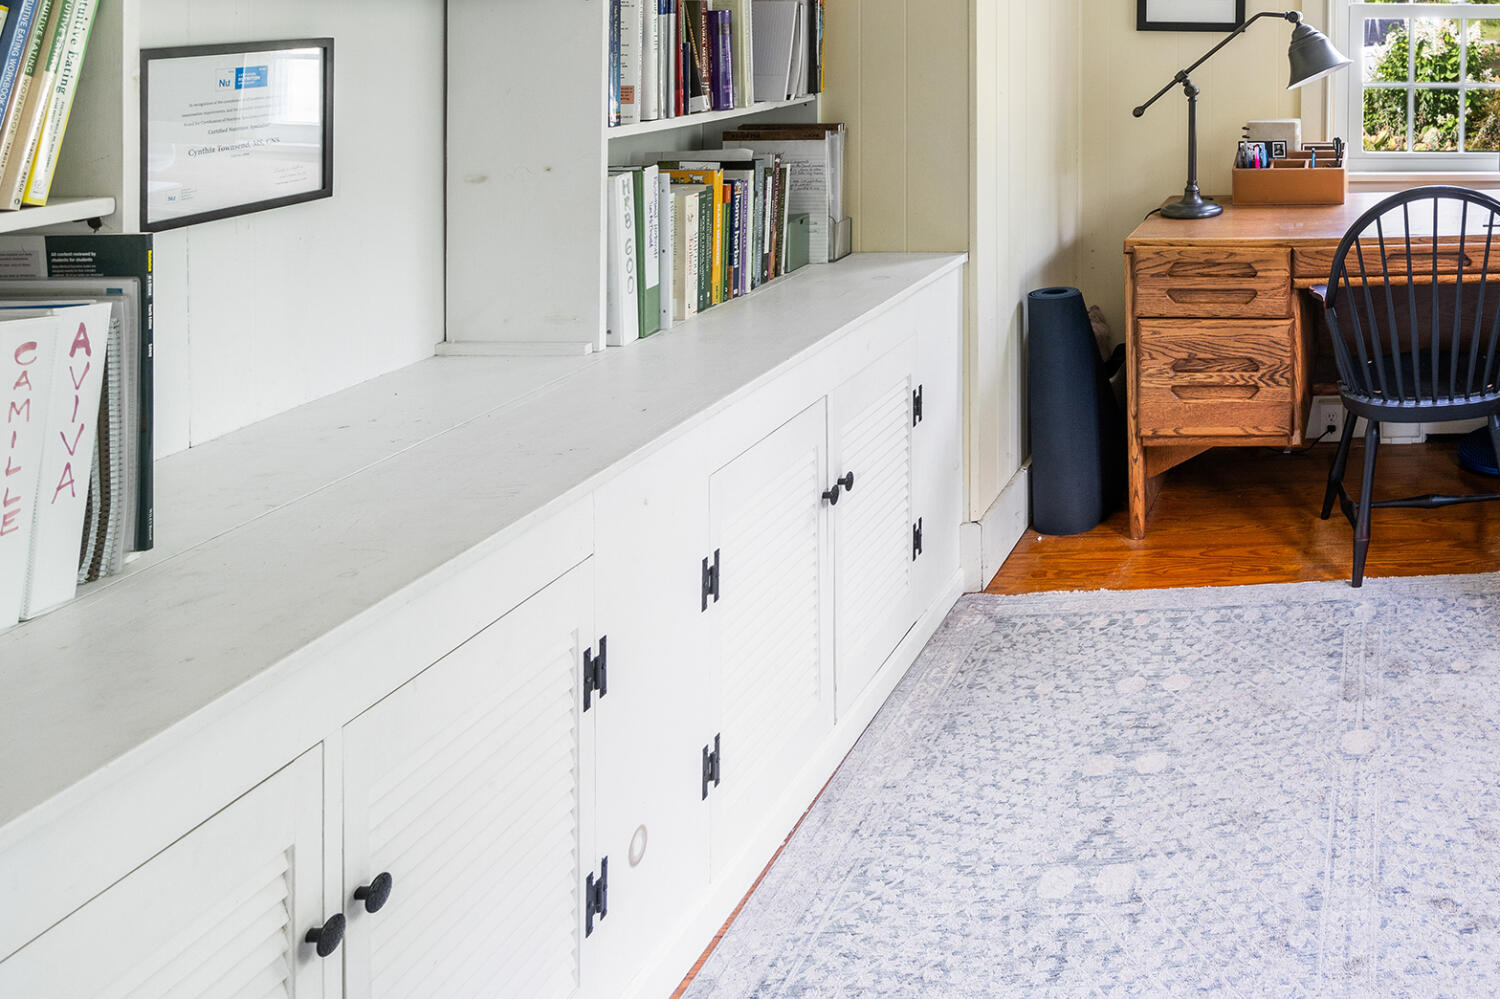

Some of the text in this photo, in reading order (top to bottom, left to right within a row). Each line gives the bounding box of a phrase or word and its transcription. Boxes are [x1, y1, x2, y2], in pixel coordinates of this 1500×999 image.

[11, 28, 29, 57] EATING
[26, 37, 44, 77] EATING
[701, 46, 709, 78] MEDICINE
[55, 50, 78, 96] Eating
[10, 77, 31, 134] WORKBOOK
[187, 146, 216, 160] Cynthia
[732, 195, 741, 269] home herbal
[625, 238, 635, 295] 600
[0, 340, 38, 537] CAMILLE
[51, 321, 92, 505] AVIVA
